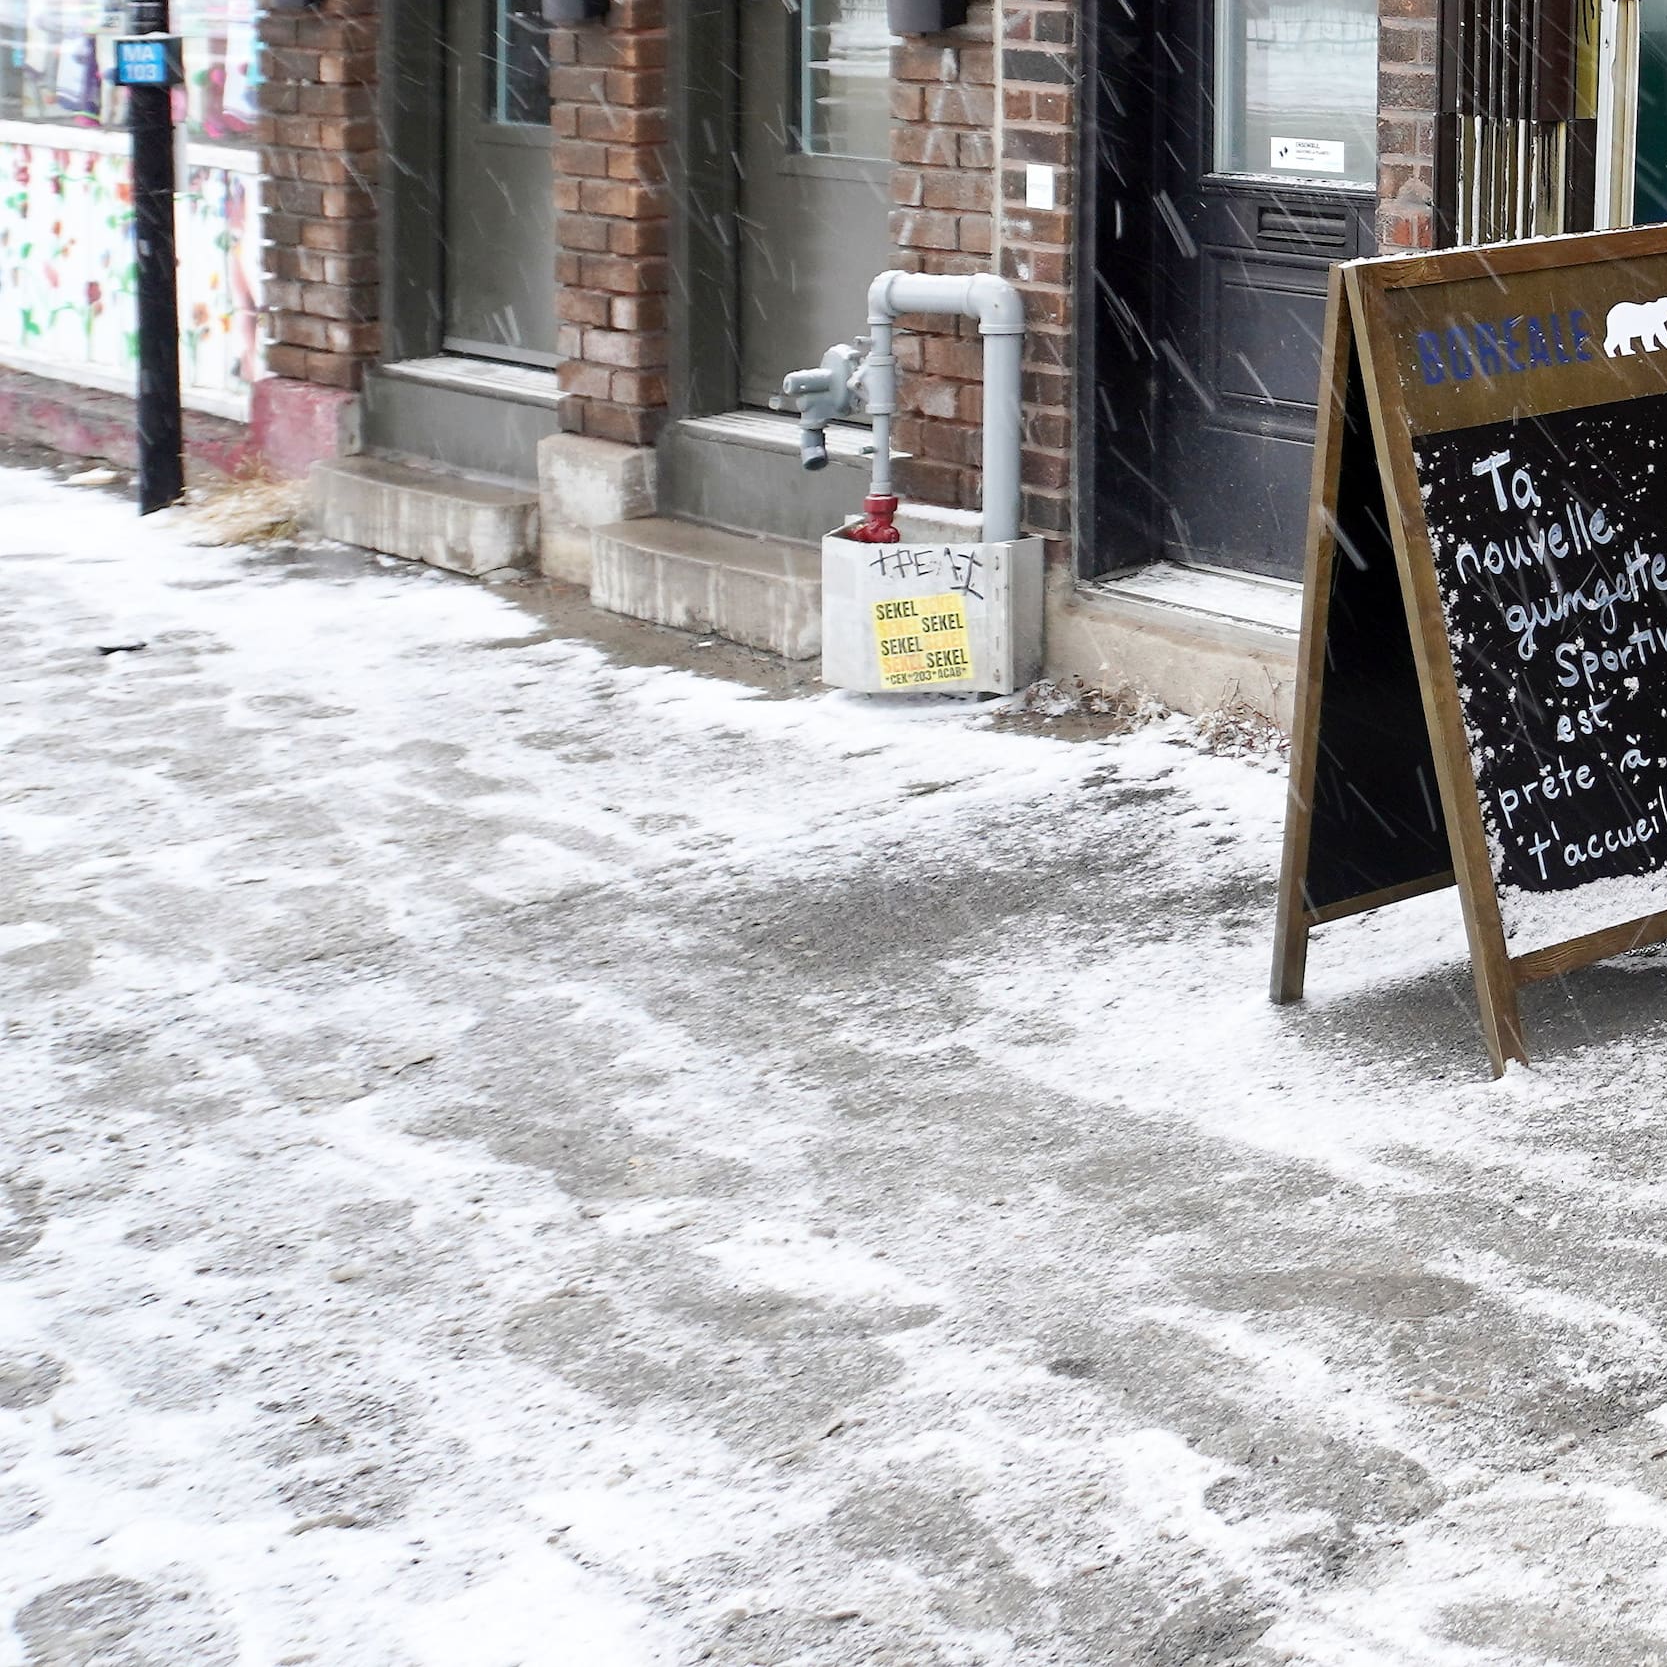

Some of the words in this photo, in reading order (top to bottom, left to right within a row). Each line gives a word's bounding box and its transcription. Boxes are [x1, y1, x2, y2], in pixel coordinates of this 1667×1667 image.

[122, 45, 156, 62] MA
[125, 64, 157, 81] 103
[1471, 449, 1542, 512] Ta
[1456, 502, 1616, 584] nouvelle
[876, 600, 919, 620] SEKEL
[921, 613, 964, 633] SEKEL
[880, 636, 924, 656] SEKEL
[926, 648, 969, 668] SEKEL
[1556, 694, 1612, 743] est
